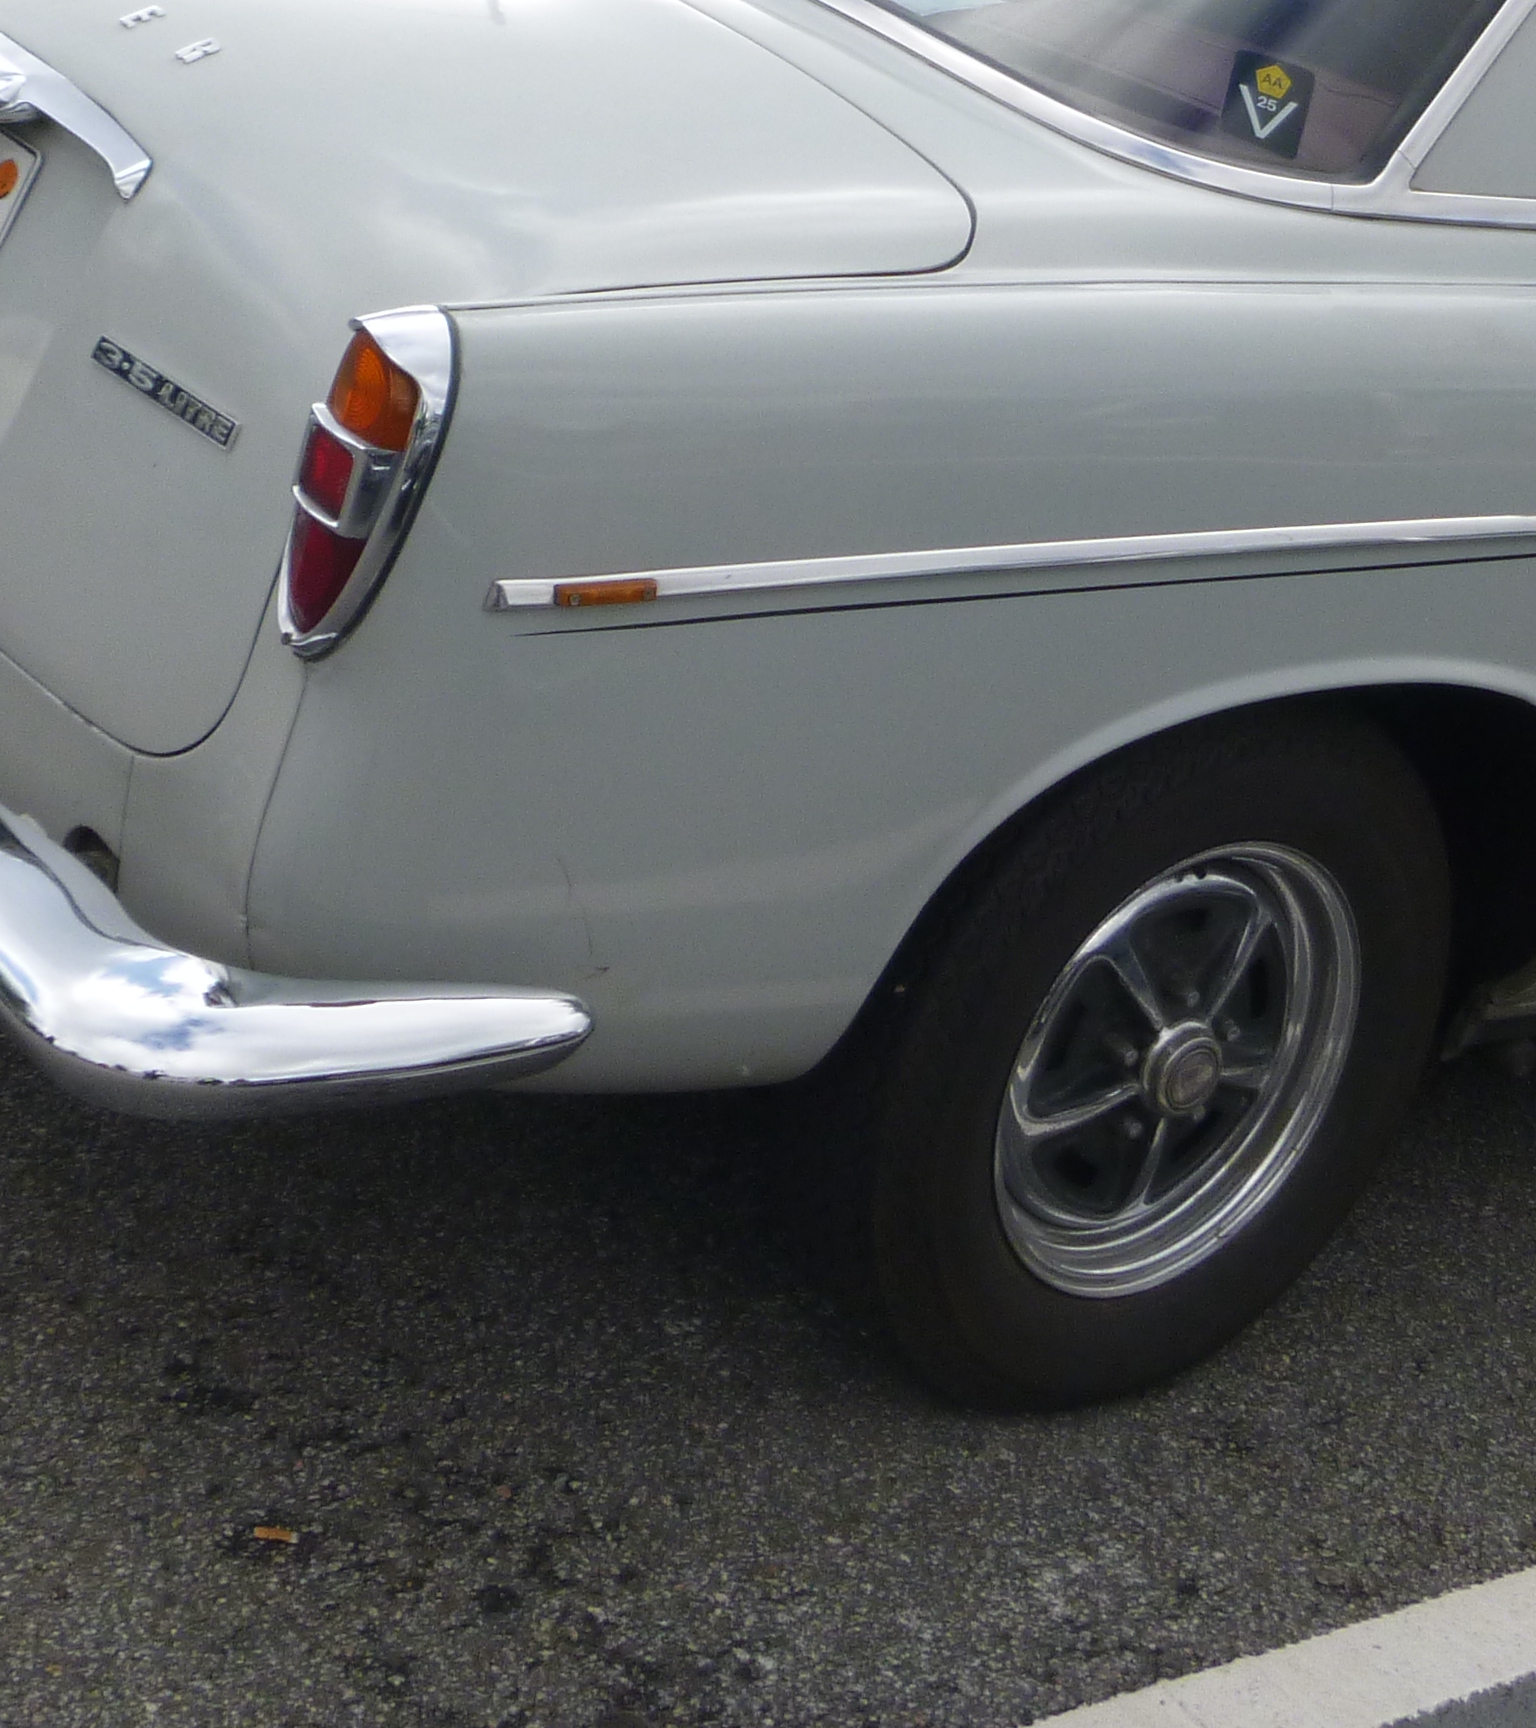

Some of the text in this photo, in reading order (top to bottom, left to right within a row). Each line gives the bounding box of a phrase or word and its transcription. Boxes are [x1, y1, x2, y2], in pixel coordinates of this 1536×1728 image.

[1262, 73, 1283, 89] AA
[1256, 95, 1277, 112] 25
[157, 381, 234, 444] LITRE
